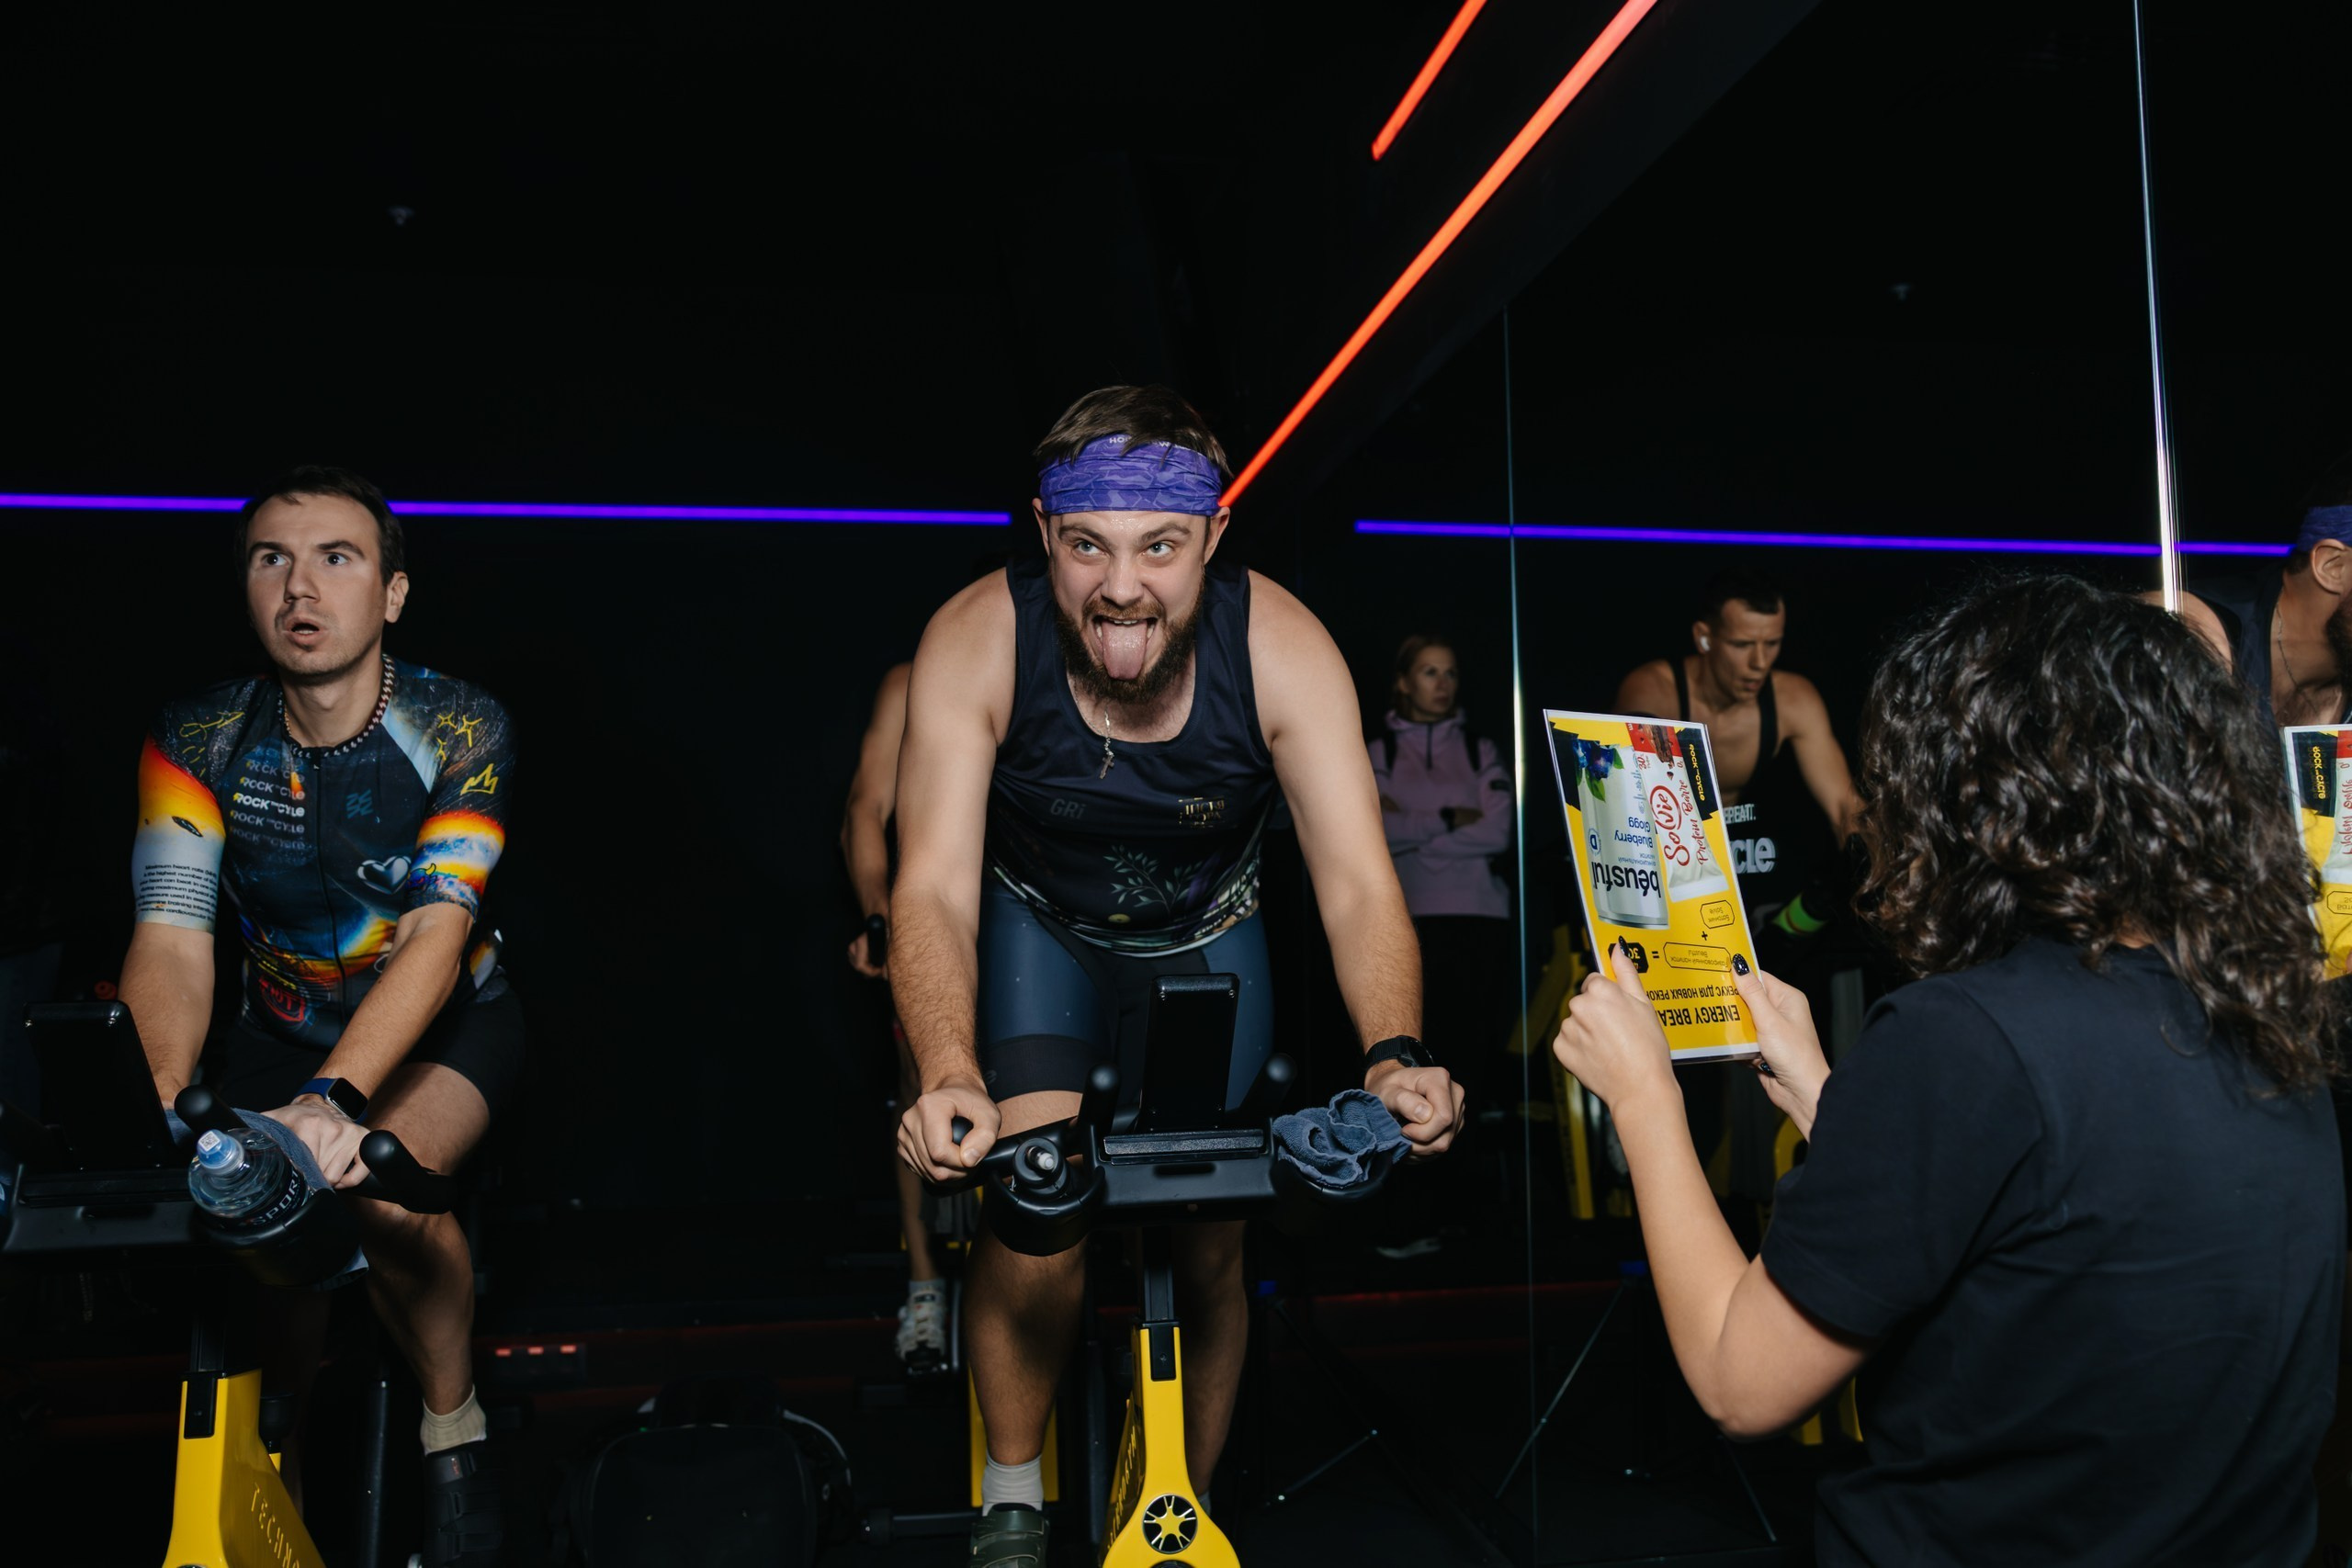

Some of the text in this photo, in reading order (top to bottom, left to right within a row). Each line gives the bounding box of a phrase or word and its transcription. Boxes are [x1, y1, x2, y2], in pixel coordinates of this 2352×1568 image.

[240, 775, 274, 793] ROCK
[232, 792, 271, 810] ROCK
[229, 809, 266, 827] ROCK
[1628, 817, 1651, 833] Glogg
[1613, 830, 1654, 848] Blueberry
[167, 899, 192, 908] training
[1669, 987, 1697, 1000] НОВЫХ
[1699, 985, 1713, 999] ДЛЯ
[1715, 986, 1739, 997] РЕКУС
[1655, 1004, 1741, 1027] ENERGY BREA
[251, 1481, 300, 1568] TECHN
